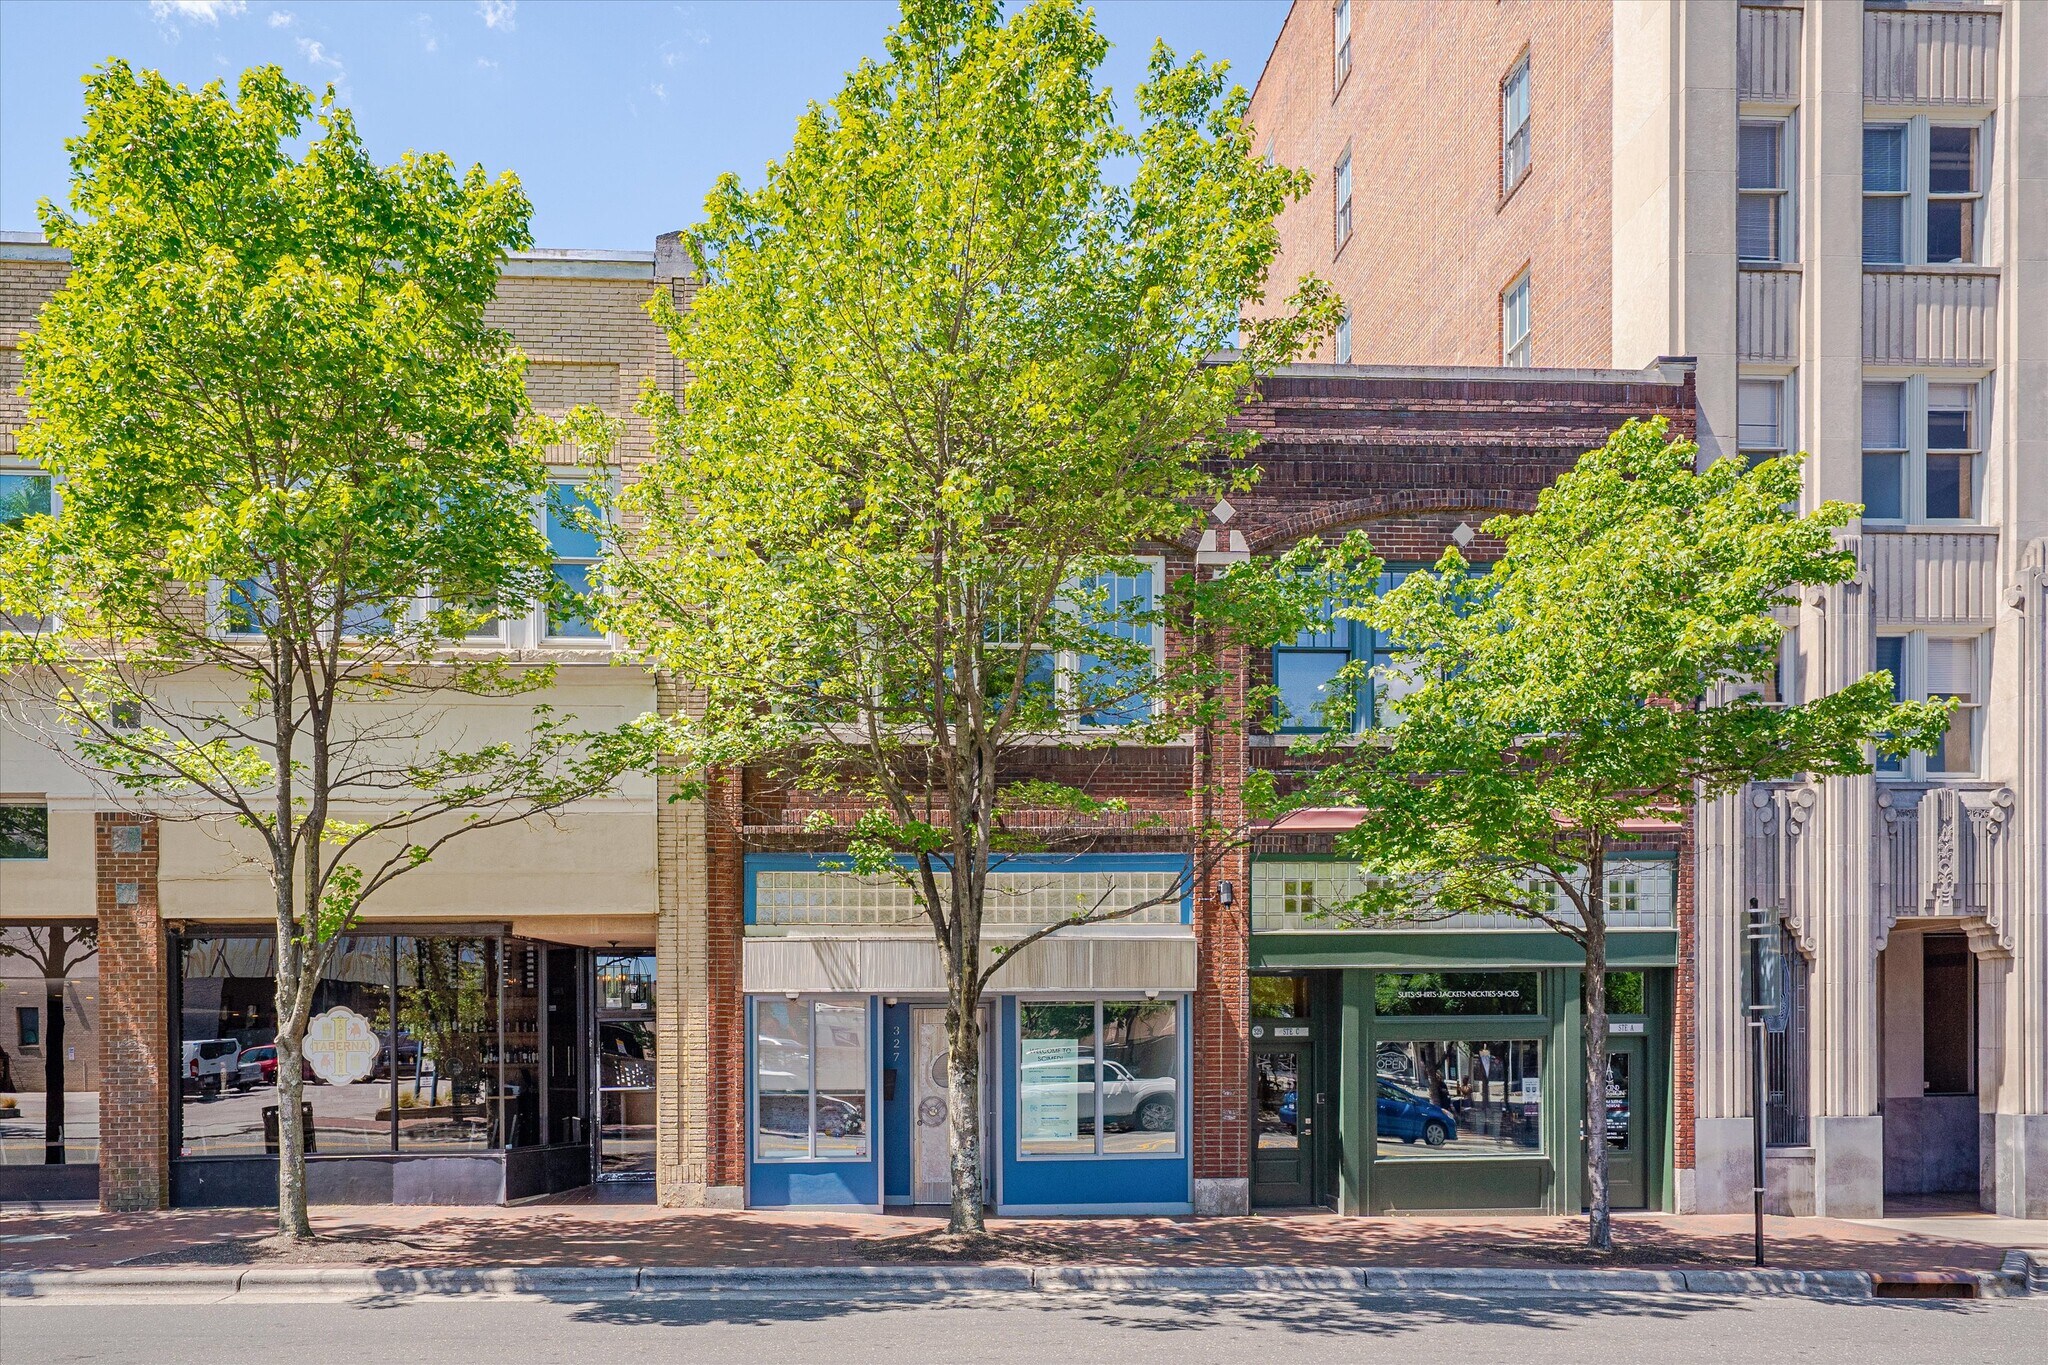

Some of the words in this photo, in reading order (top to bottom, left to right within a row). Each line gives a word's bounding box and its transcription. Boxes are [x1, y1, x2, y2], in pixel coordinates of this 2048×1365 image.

[1282, 1027, 1294, 1035] STE
[314, 1041, 367, 1051] TABERNA
[1376, 1059, 1406, 1069] OPEN
